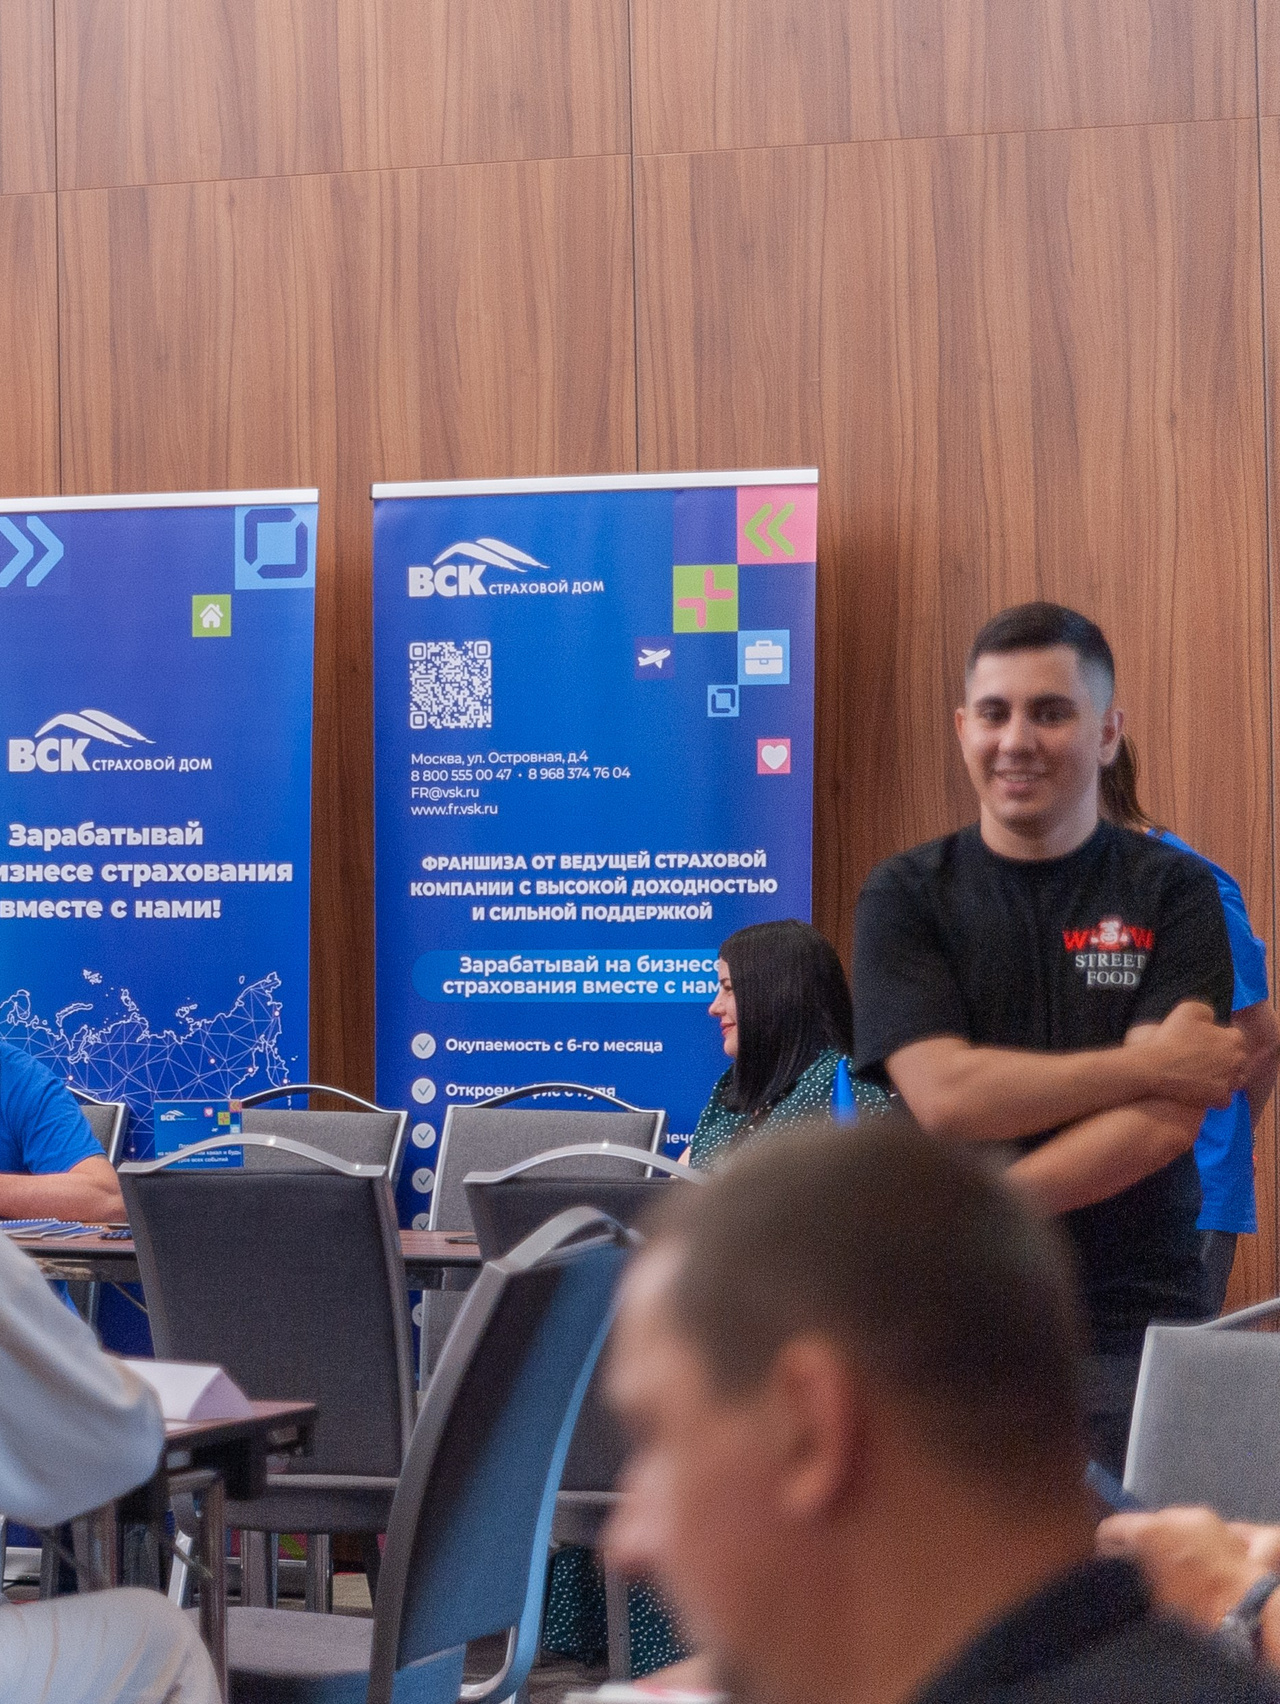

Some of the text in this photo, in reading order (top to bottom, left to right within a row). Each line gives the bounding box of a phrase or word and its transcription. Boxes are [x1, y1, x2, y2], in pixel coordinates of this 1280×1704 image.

[409, 565, 604, 596] ВСК СТРАХОВОЙ ДОМ
[9, 738, 212, 772] ВСК СТРАХОВОЙ ДОМ
[411, 751, 589, 768] Москва, ул. Островная, д.4
[411, 767, 631, 781] 8 800 555 00 47 8 968 374 76 04
[411, 786, 479, 800] FR@vsk.ru
[411, 802, 498, 815] www.fr.vsk.ru
[9, 821, 203, 851] Зарабатывай
[422, 849, 766, 871] ФРАНШИЗА ОТ ВЕДУЩЕЙ СТРАХОВОЙ
[101, 863, 292, 887] страхования
[411, 876, 778, 896] КОМПАНИИ С ВЫСОКОЙ ДОХОДНОСТЬЮ
[0, 899, 221, 918] вместе с нами!
[472, 902, 712, 922] И СИЛЬНОЙ ПОДДЕРЖКОЙ
[460, 955, 598, 976] Зарабатывай
[606, 960, 630, 972] на
[1075, 952, 1145, 969] STREET
[1086, 971, 1136, 986] FOOD
[443, 980, 721, 997] страхования вместе с нам
[445, 1038, 663, 1054] Окупаемость с 6-го месяца
